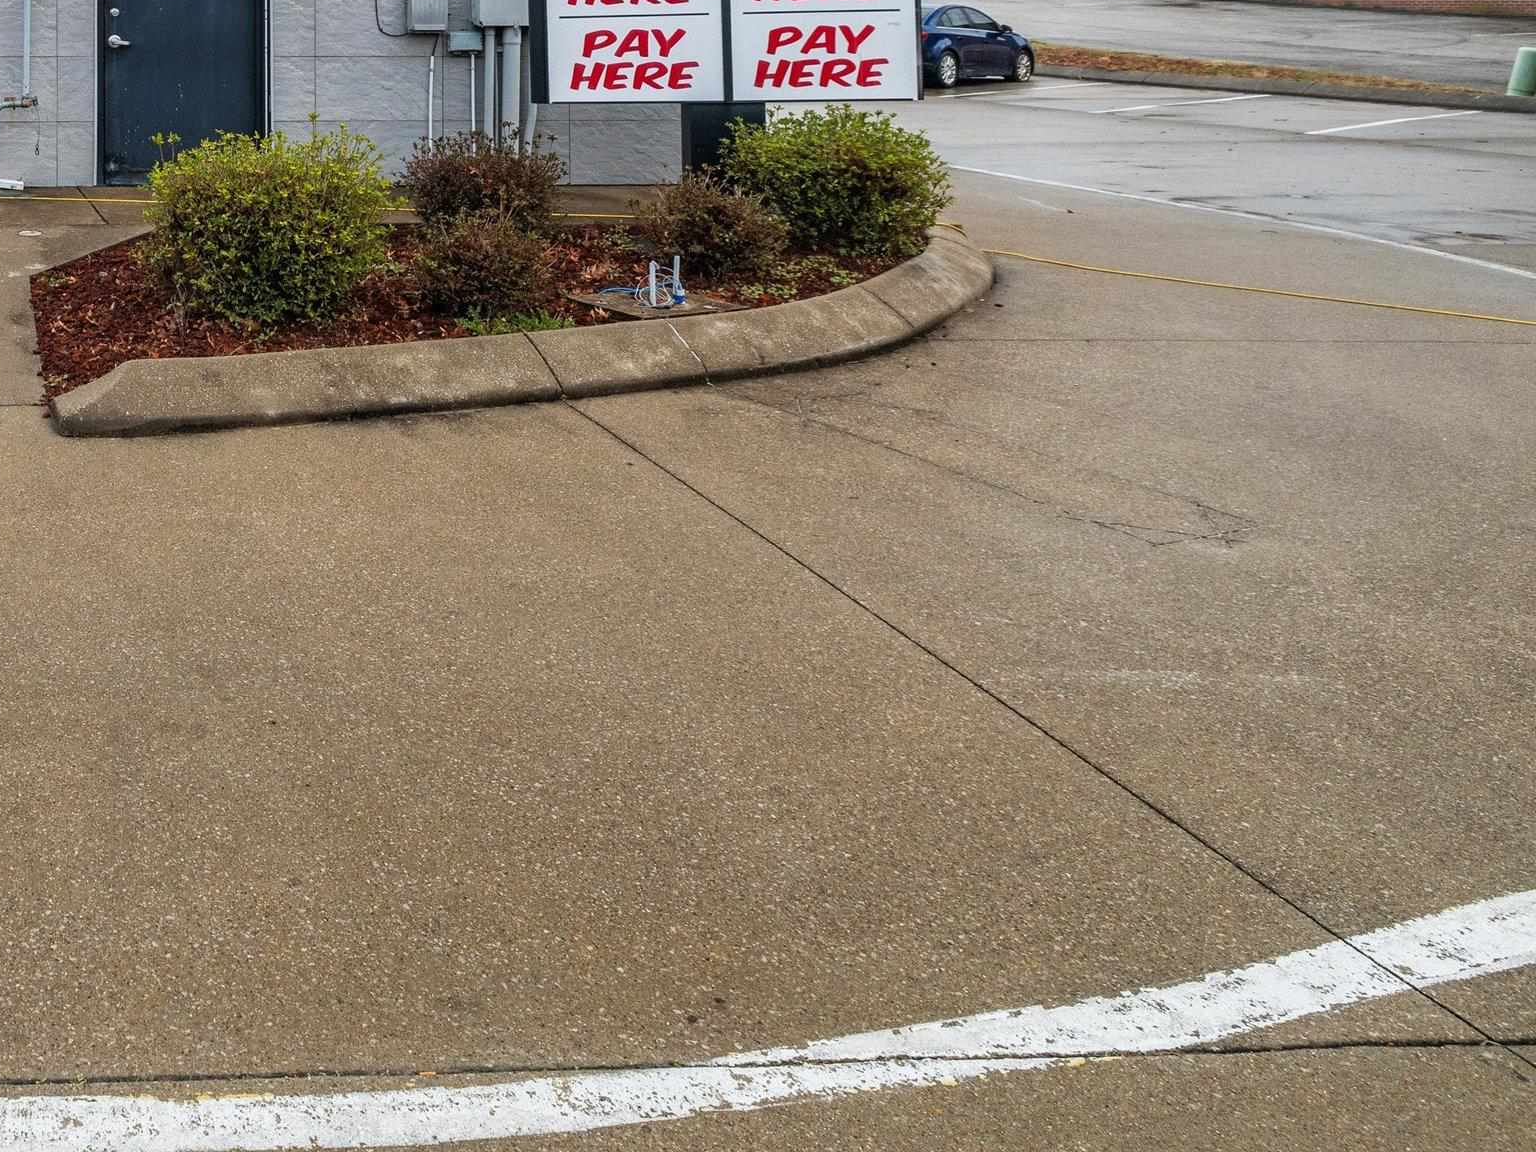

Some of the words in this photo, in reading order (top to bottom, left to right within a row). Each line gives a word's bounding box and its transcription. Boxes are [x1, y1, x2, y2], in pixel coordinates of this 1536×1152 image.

[582, 28, 687, 58] PAY
[766, 24, 876, 56] PAY
[569, 60, 700, 91] HERE
[753, 57, 889, 89] HERE
